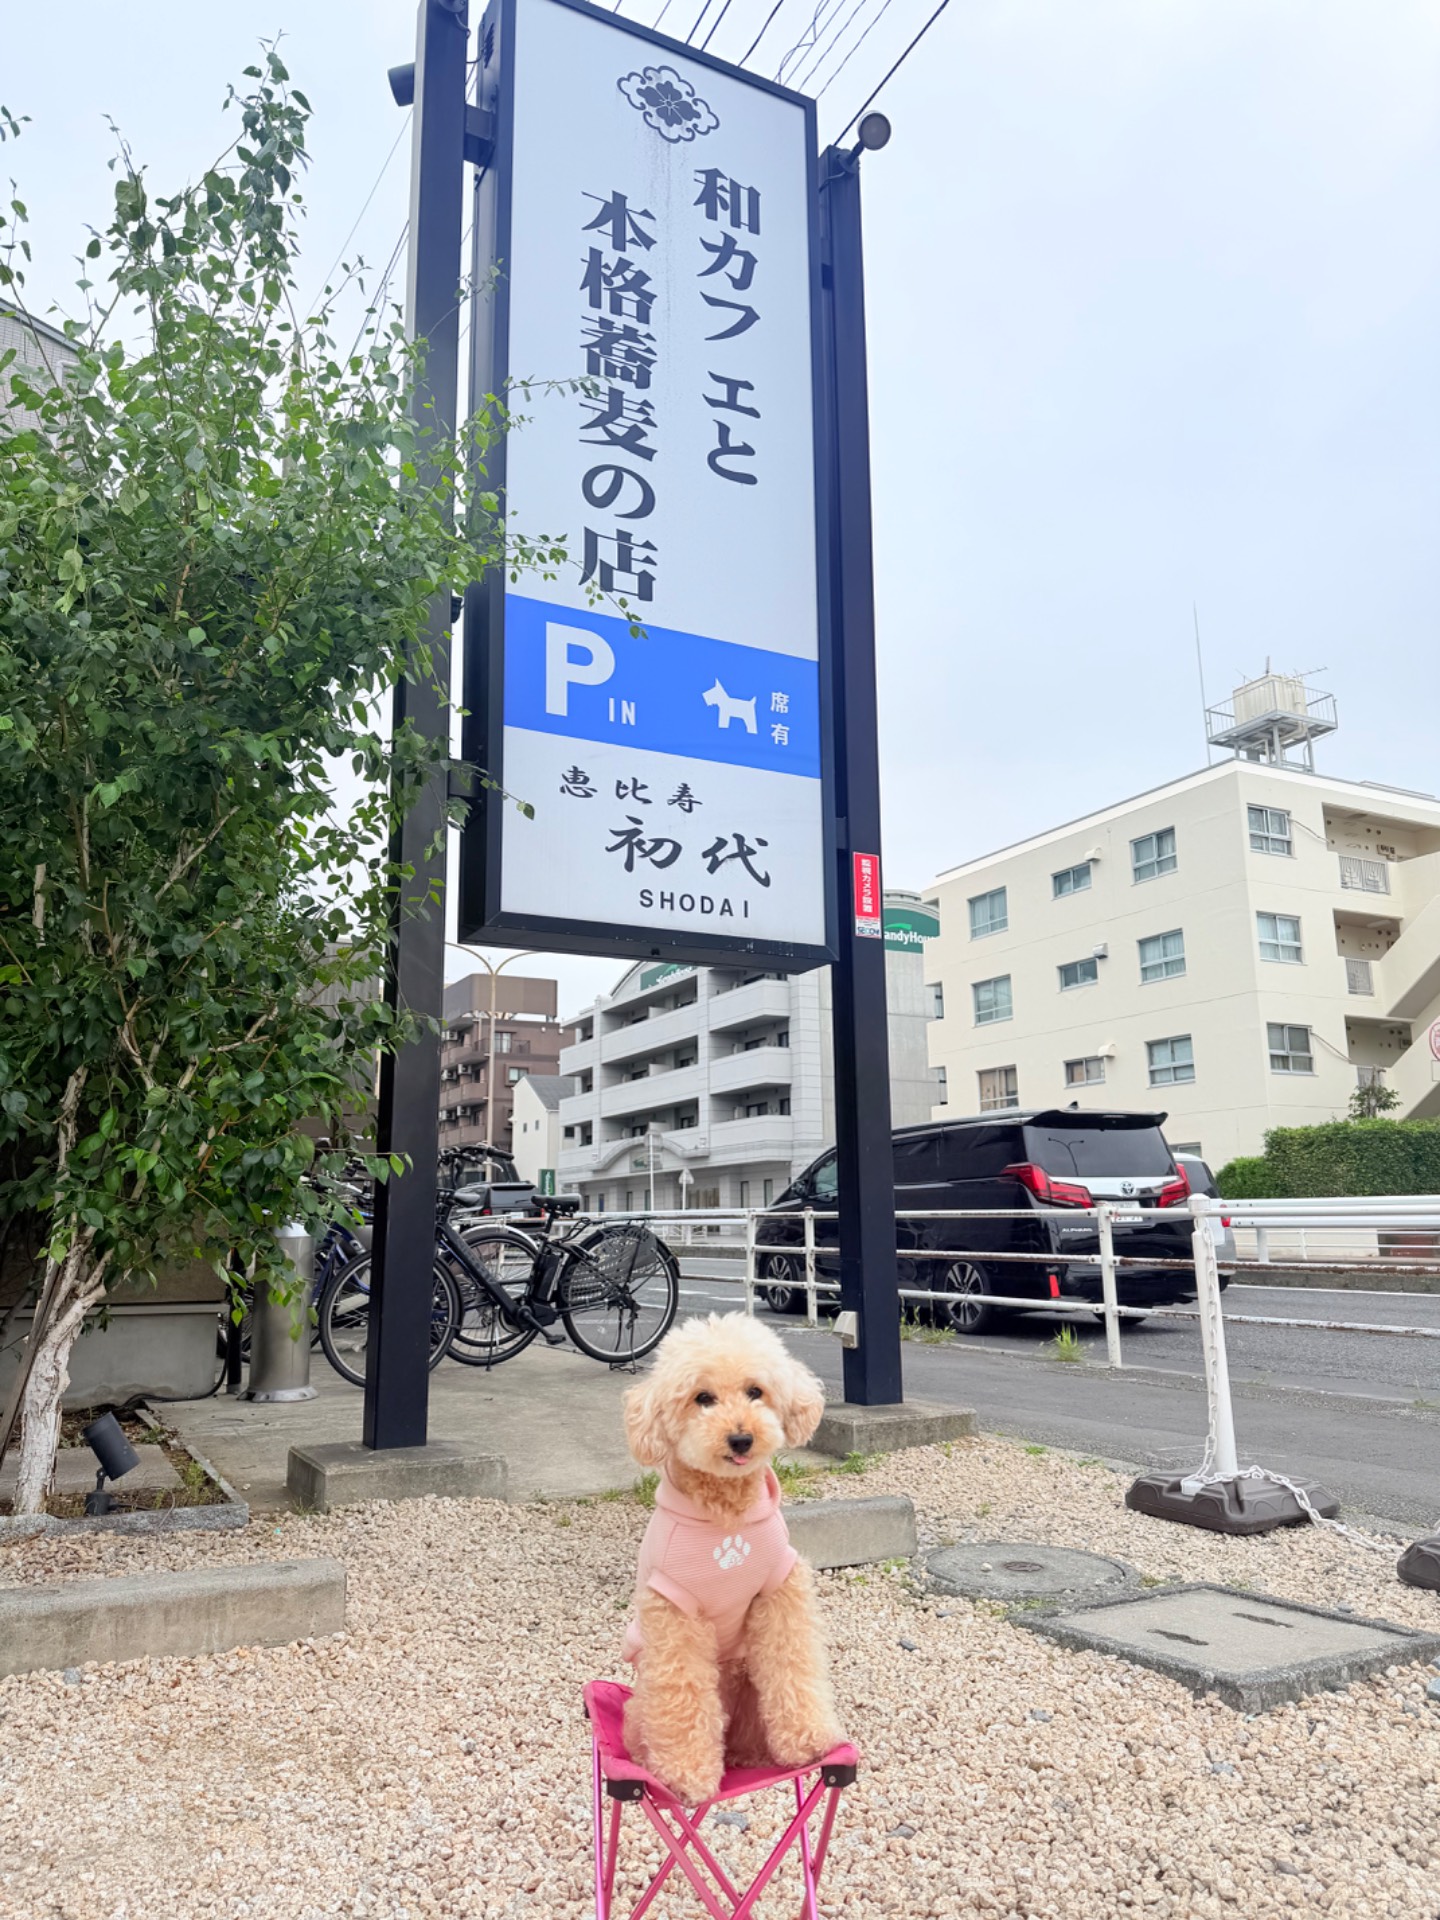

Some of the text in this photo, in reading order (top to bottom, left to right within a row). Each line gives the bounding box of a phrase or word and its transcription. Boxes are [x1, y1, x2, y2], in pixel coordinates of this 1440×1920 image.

[579, 191, 658, 602] 本格蕎麦の店
[545, 621, 636, 726] P IN
[559, 765, 703, 814] 恵比寿
[605, 815, 771, 888] 初代
[639, 889, 749, 919] SHODAI
